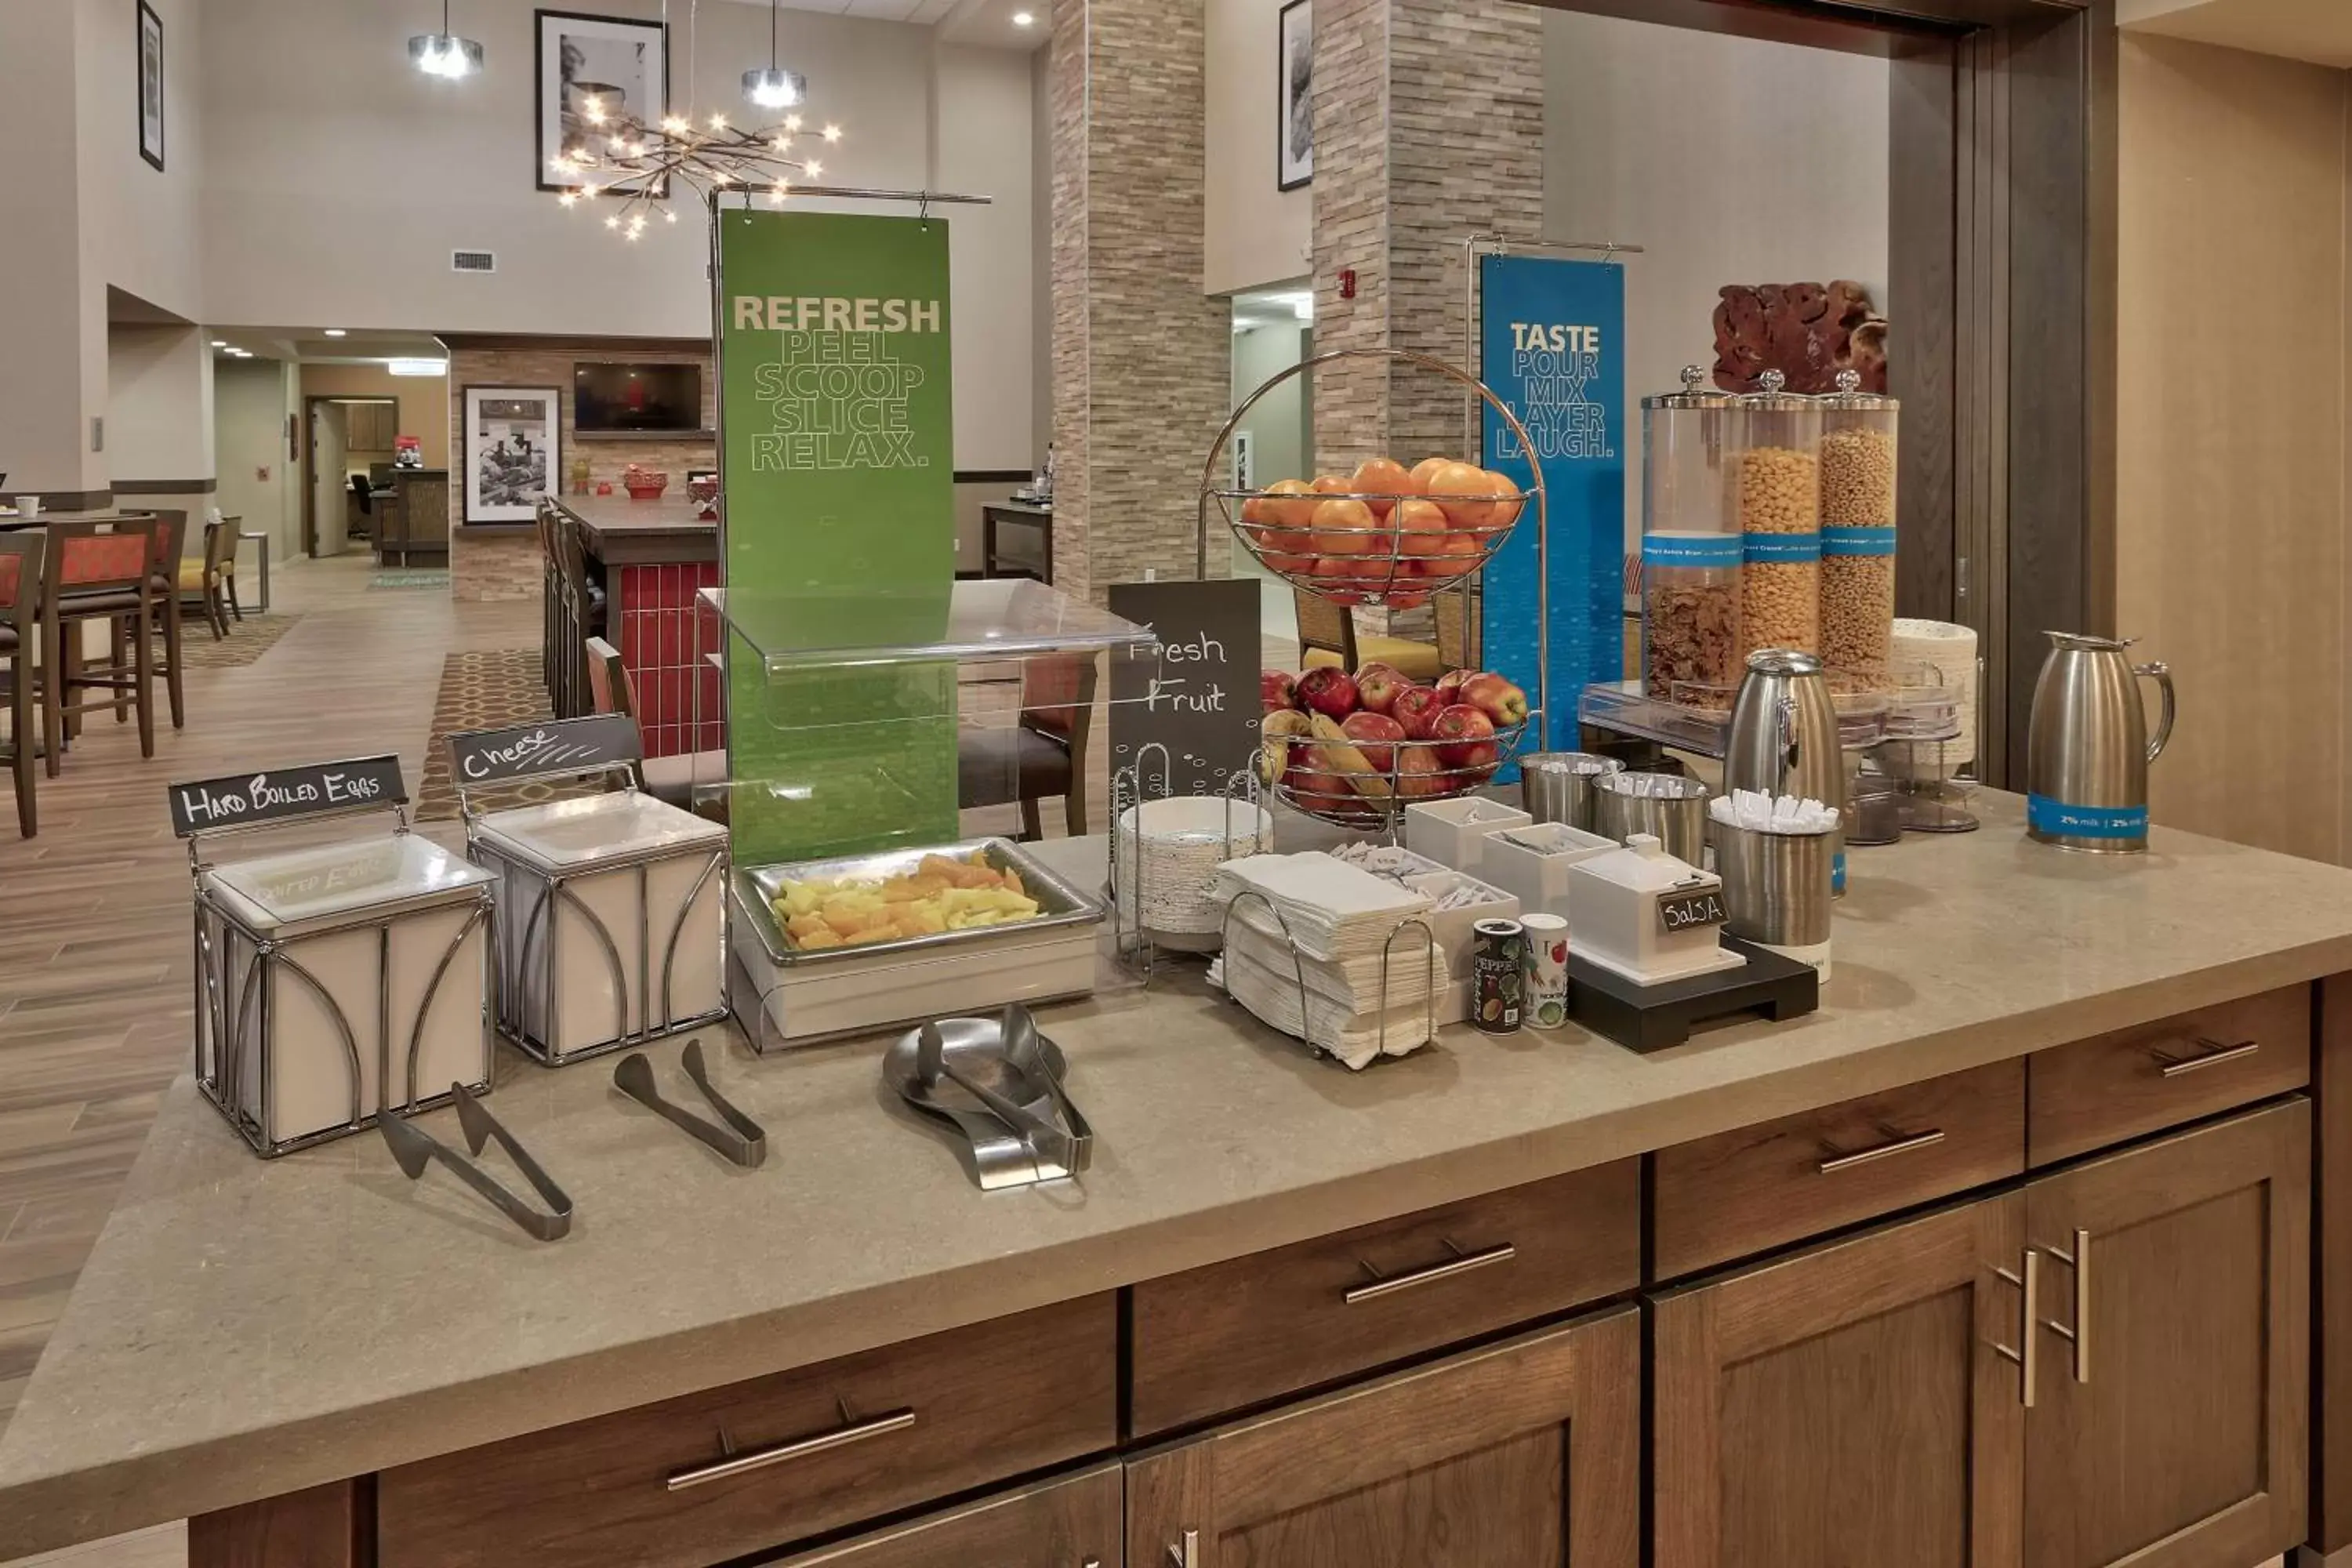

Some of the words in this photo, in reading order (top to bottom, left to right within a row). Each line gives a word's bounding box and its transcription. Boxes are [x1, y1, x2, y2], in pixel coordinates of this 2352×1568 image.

[733, 296, 940, 333] REFRESH
[782, 329, 899, 365] PEEL
[1510, 322, 1599, 352] TASTE
[754, 363, 924, 401] SCOOP
[1512, 349, 1599, 379] POUR
[1525, 376, 1587, 405] MIX
[772, 397, 909, 434] SLICE
[1506, 401, 1606, 430] LAYER
[751, 431, 929, 471] RELAX.
[1497, 428, 1614, 459] LAUGH.
[1130, 622, 1227, 662] Fresh
[1149, 678, 1225, 713] Fruit
[463, 730, 559, 778] Cheese
[181, 787, 247, 822] HARD
[249, 773, 319, 810] BOILED
[322, 773, 381, 802] EGGS
